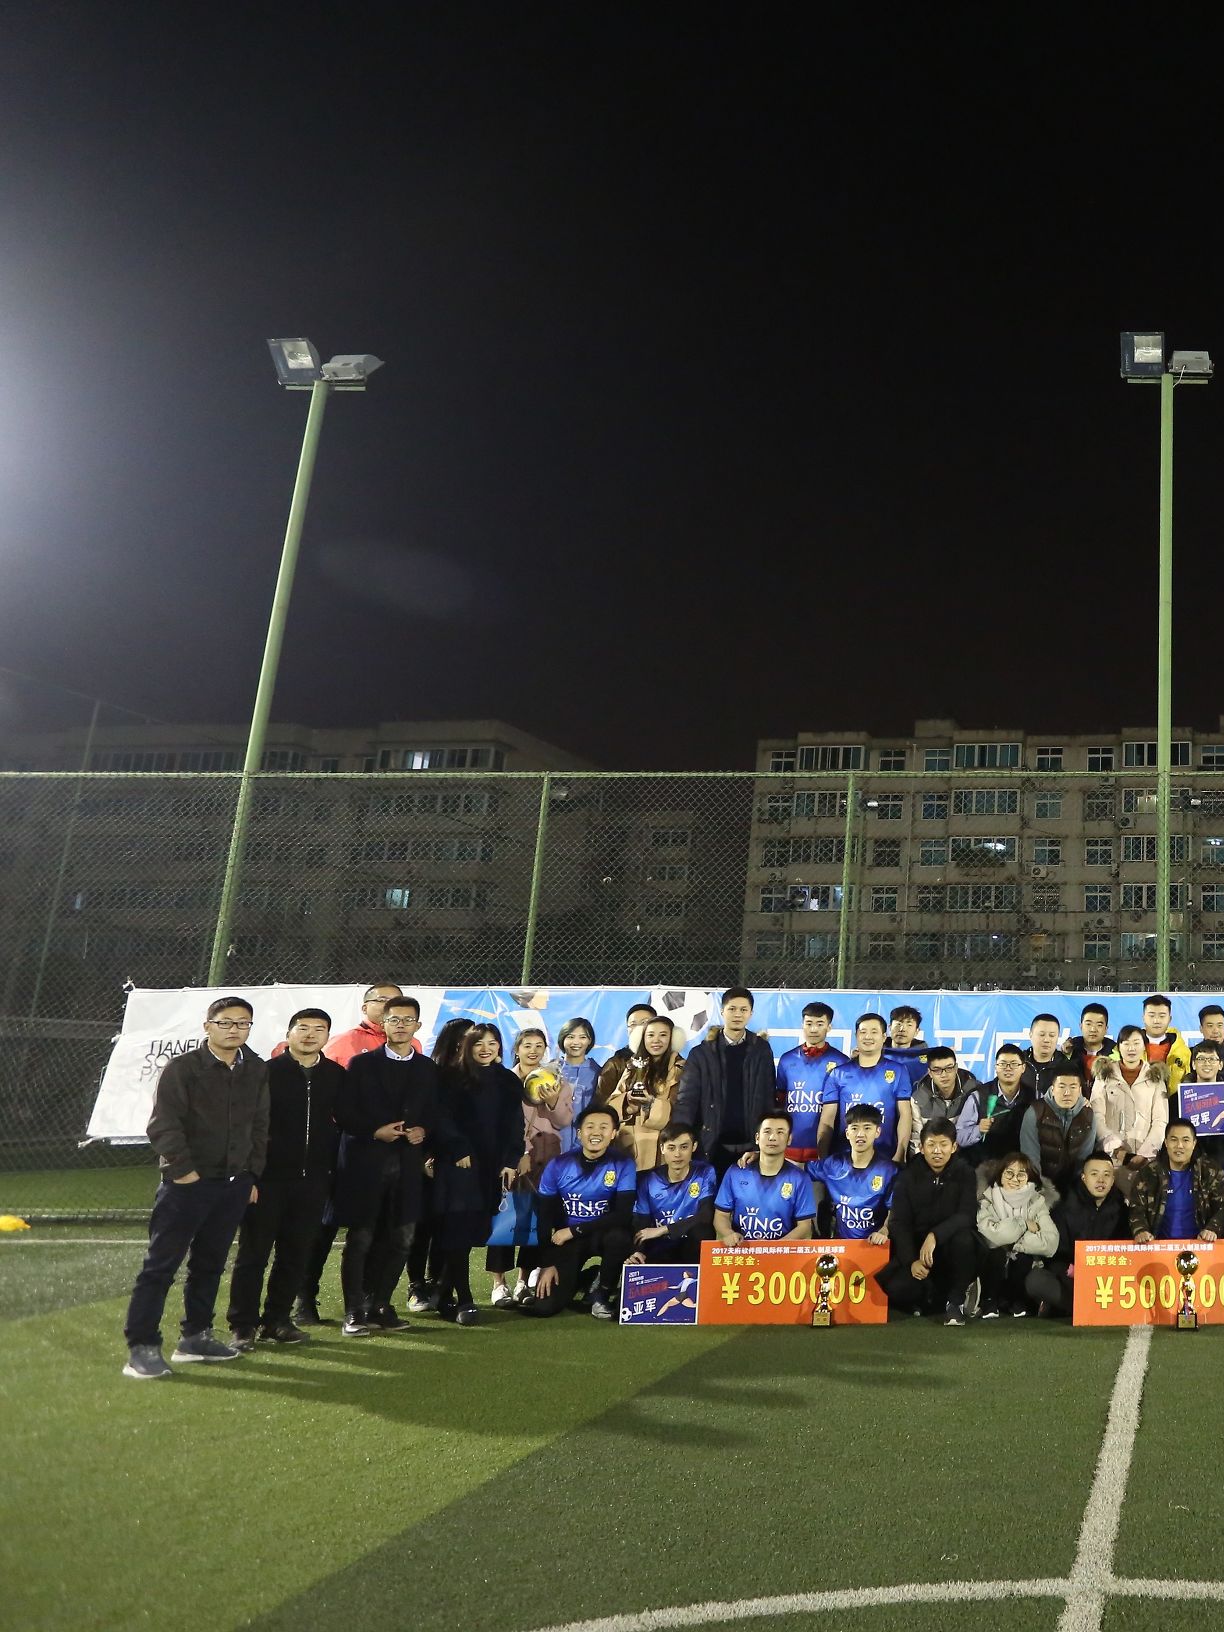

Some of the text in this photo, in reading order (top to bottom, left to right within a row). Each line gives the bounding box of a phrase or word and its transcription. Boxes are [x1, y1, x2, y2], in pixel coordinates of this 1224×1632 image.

[1190, 1111, 1211, 1127] 冠军
[739, 1214, 783, 1232] KING
[632, 1297, 657, 1316] 亚军
